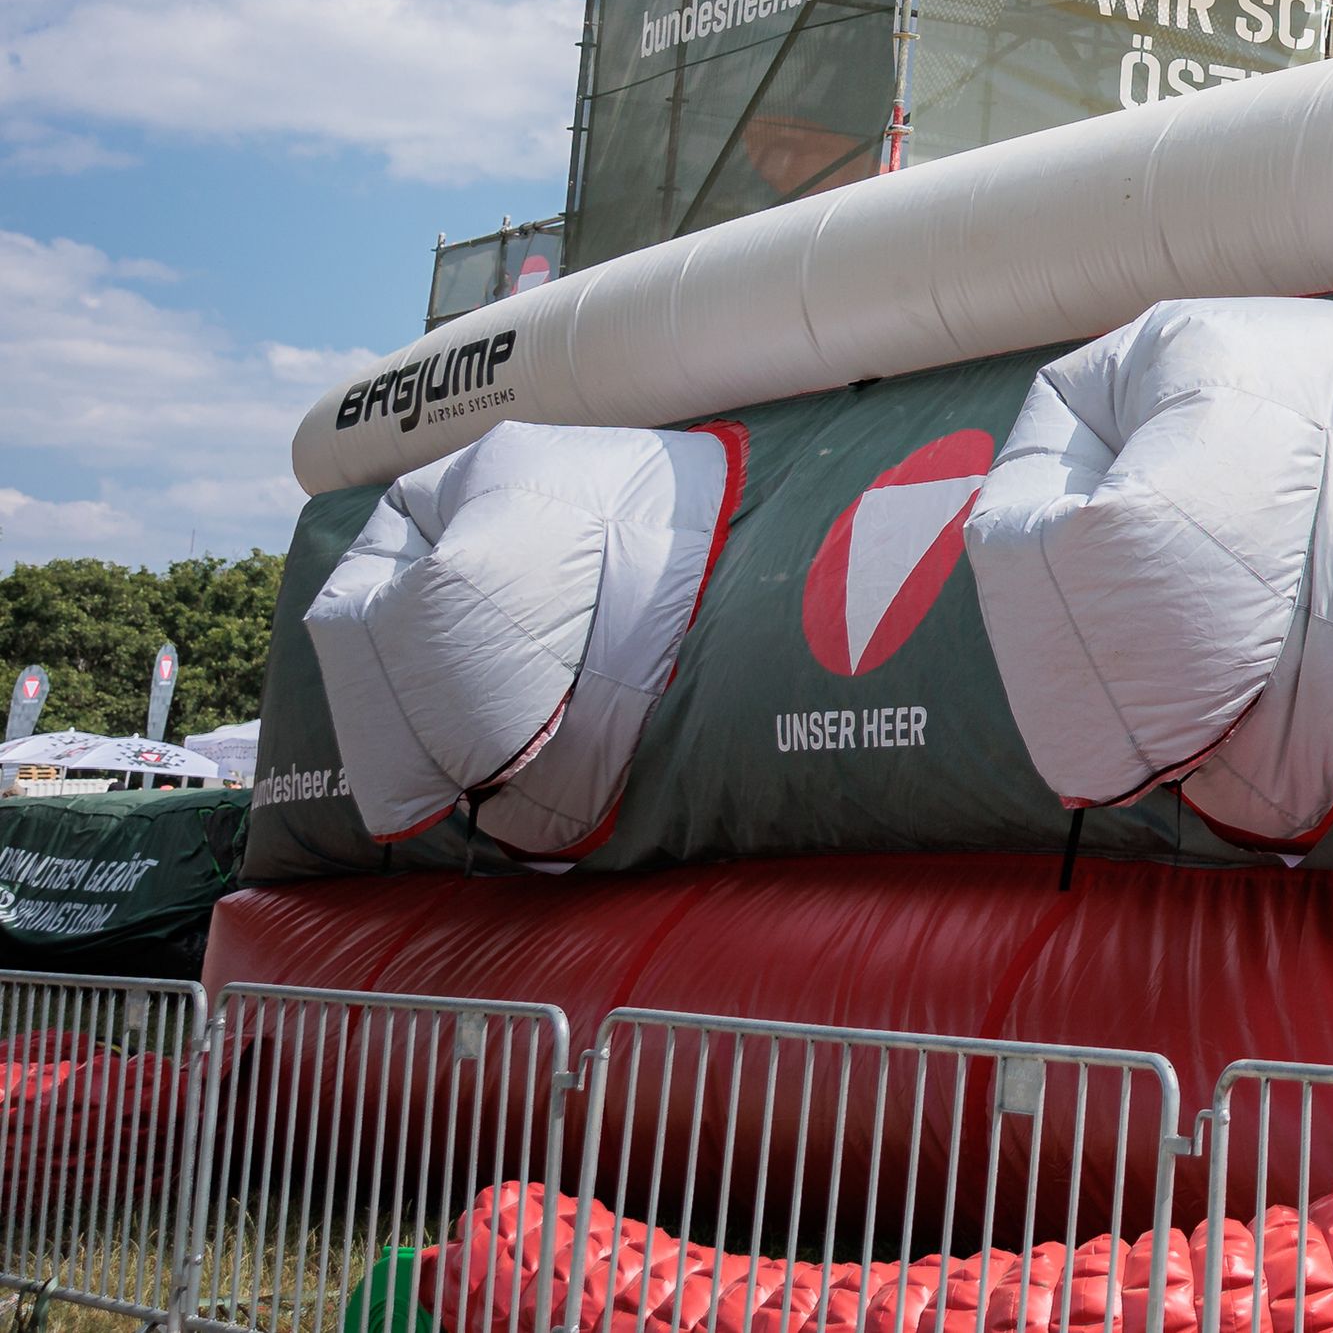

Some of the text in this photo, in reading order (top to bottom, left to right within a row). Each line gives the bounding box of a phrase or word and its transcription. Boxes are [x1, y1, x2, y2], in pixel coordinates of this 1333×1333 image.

[336, 330, 516, 433] BAGJUMP
[427, 388, 516, 425] AIRBAG SYSTEMS
[776, 705, 927, 752] UNSER HEER
